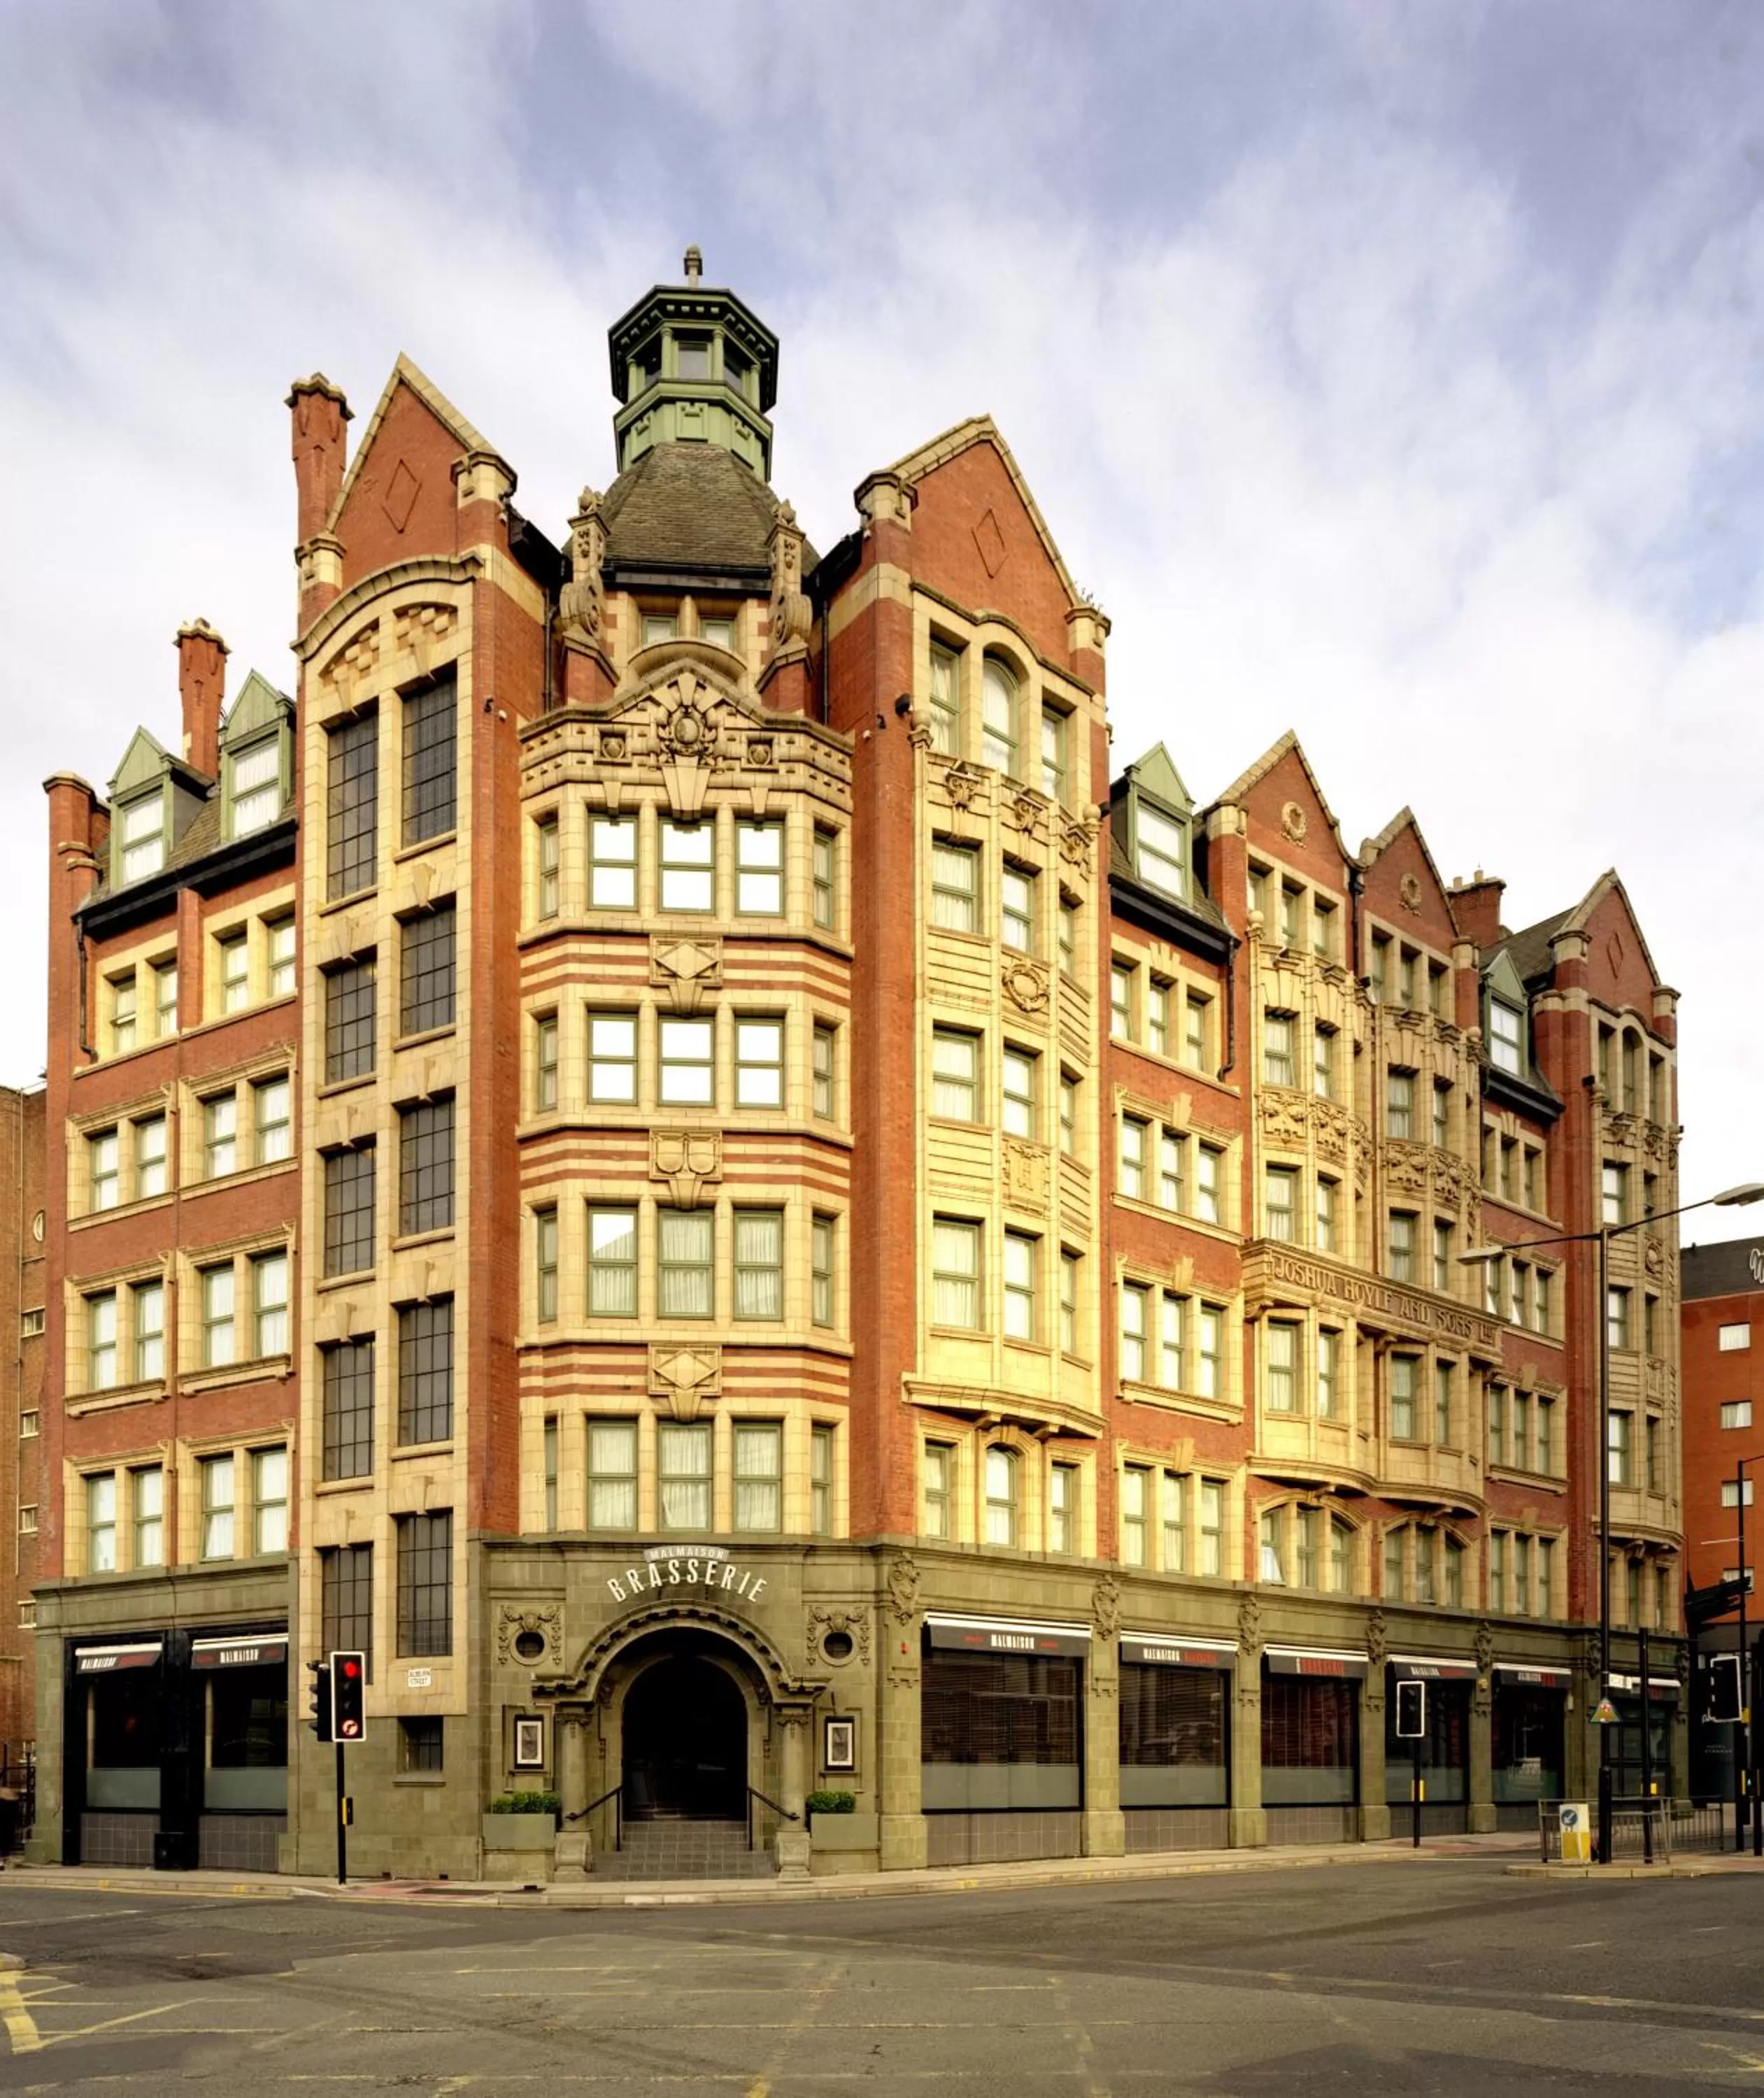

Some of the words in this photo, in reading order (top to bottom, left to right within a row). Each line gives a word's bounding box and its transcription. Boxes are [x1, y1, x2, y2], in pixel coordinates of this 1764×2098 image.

[1274, 1255, 1337, 1295] JOSHUA
[1344, 1278, 1393, 1313] HOYLE
[1400, 1297, 1431, 1322] AND
[1437, 1310, 1474, 1337] SONS
[648, 1546, 725, 1560] MALMAISON
[606, 1559, 767, 1602] BRASSERIE
